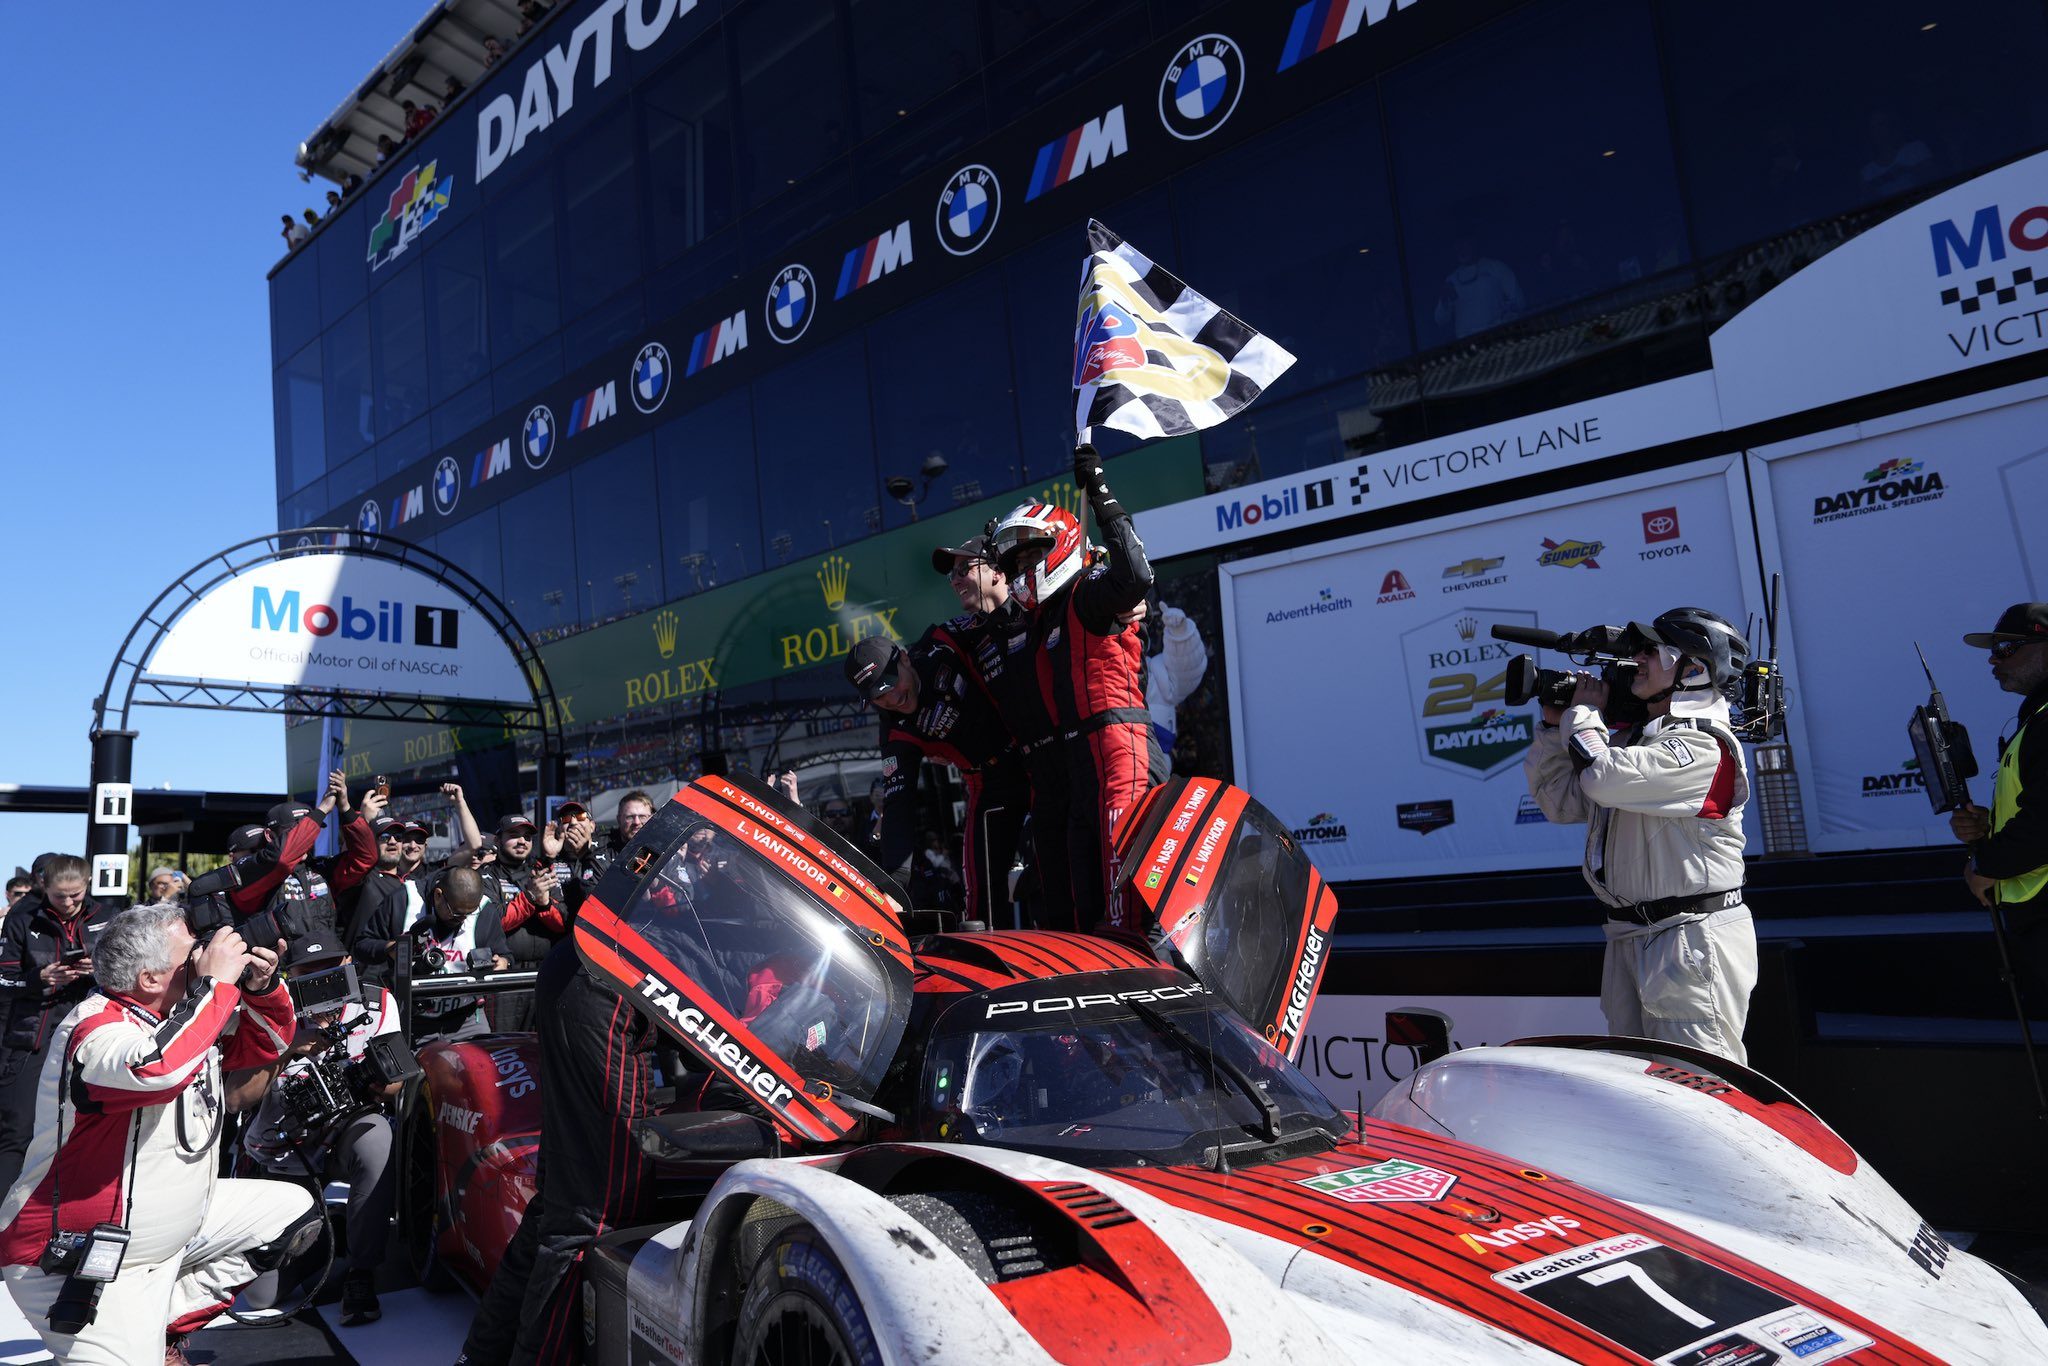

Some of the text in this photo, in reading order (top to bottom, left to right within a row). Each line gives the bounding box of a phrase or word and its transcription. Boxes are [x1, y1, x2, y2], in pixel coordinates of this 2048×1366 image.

[476, 0, 698, 185] DAYTO
[1215, 487, 1299, 532] Mobil
[1383, 440, 1507, 489] VICTORY
[1519, 418, 1602, 458] LANE
[1813, 491, 1944, 525] INTERNATIONAL SPEEDWAY
[1814, 472, 1944, 516] DAYTONA
[1542, 543, 1600, 564] SUNOCO
[1638, 544, 1691, 561] TOYOTA
[1376, 591, 1416, 604] AXALTA
[1442, 575, 1508, 594] CHEVROLET
[251, 586, 402, 644] Mobil
[780, 607, 903, 669] ROLEX
[1428, 642, 1512, 669] ROLEX
[250, 646, 459, 677] Official Motor Oil of NASCAR
[625, 657, 718, 708] ROLEX
[404, 727, 463, 764] ROLEX
[1433, 724, 1528, 750] DAYTONA
[342, 752, 372, 777] LEX
[722, 786, 784, 825] N. TANDY
[1185, 785, 1209, 811] TANDY
[1862, 787, 1921, 798] INTERNATIONAL
[737, 820, 827, 885] L. VANTHOOR
[1152, 838, 1179, 874] F. NASR
[1191, 816, 1229, 873] L. VANTHOOR
[818, 849, 867, 888] F. NASR
[985, 982, 1213, 1019] PORSCHE
[438, 1102, 484, 1134] PENSKE
[1310, 1160, 1412, 1189] TAG
[1339, 1171, 1447, 1200] HEUER
[1459, 1215, 1580, 1254] Ansys
[1505, 1236, 1649, 1284] WeatherTech
[1577, 1260, 1716, 1329] 7
[633, 1313, 685, 1363] WeatherTech
